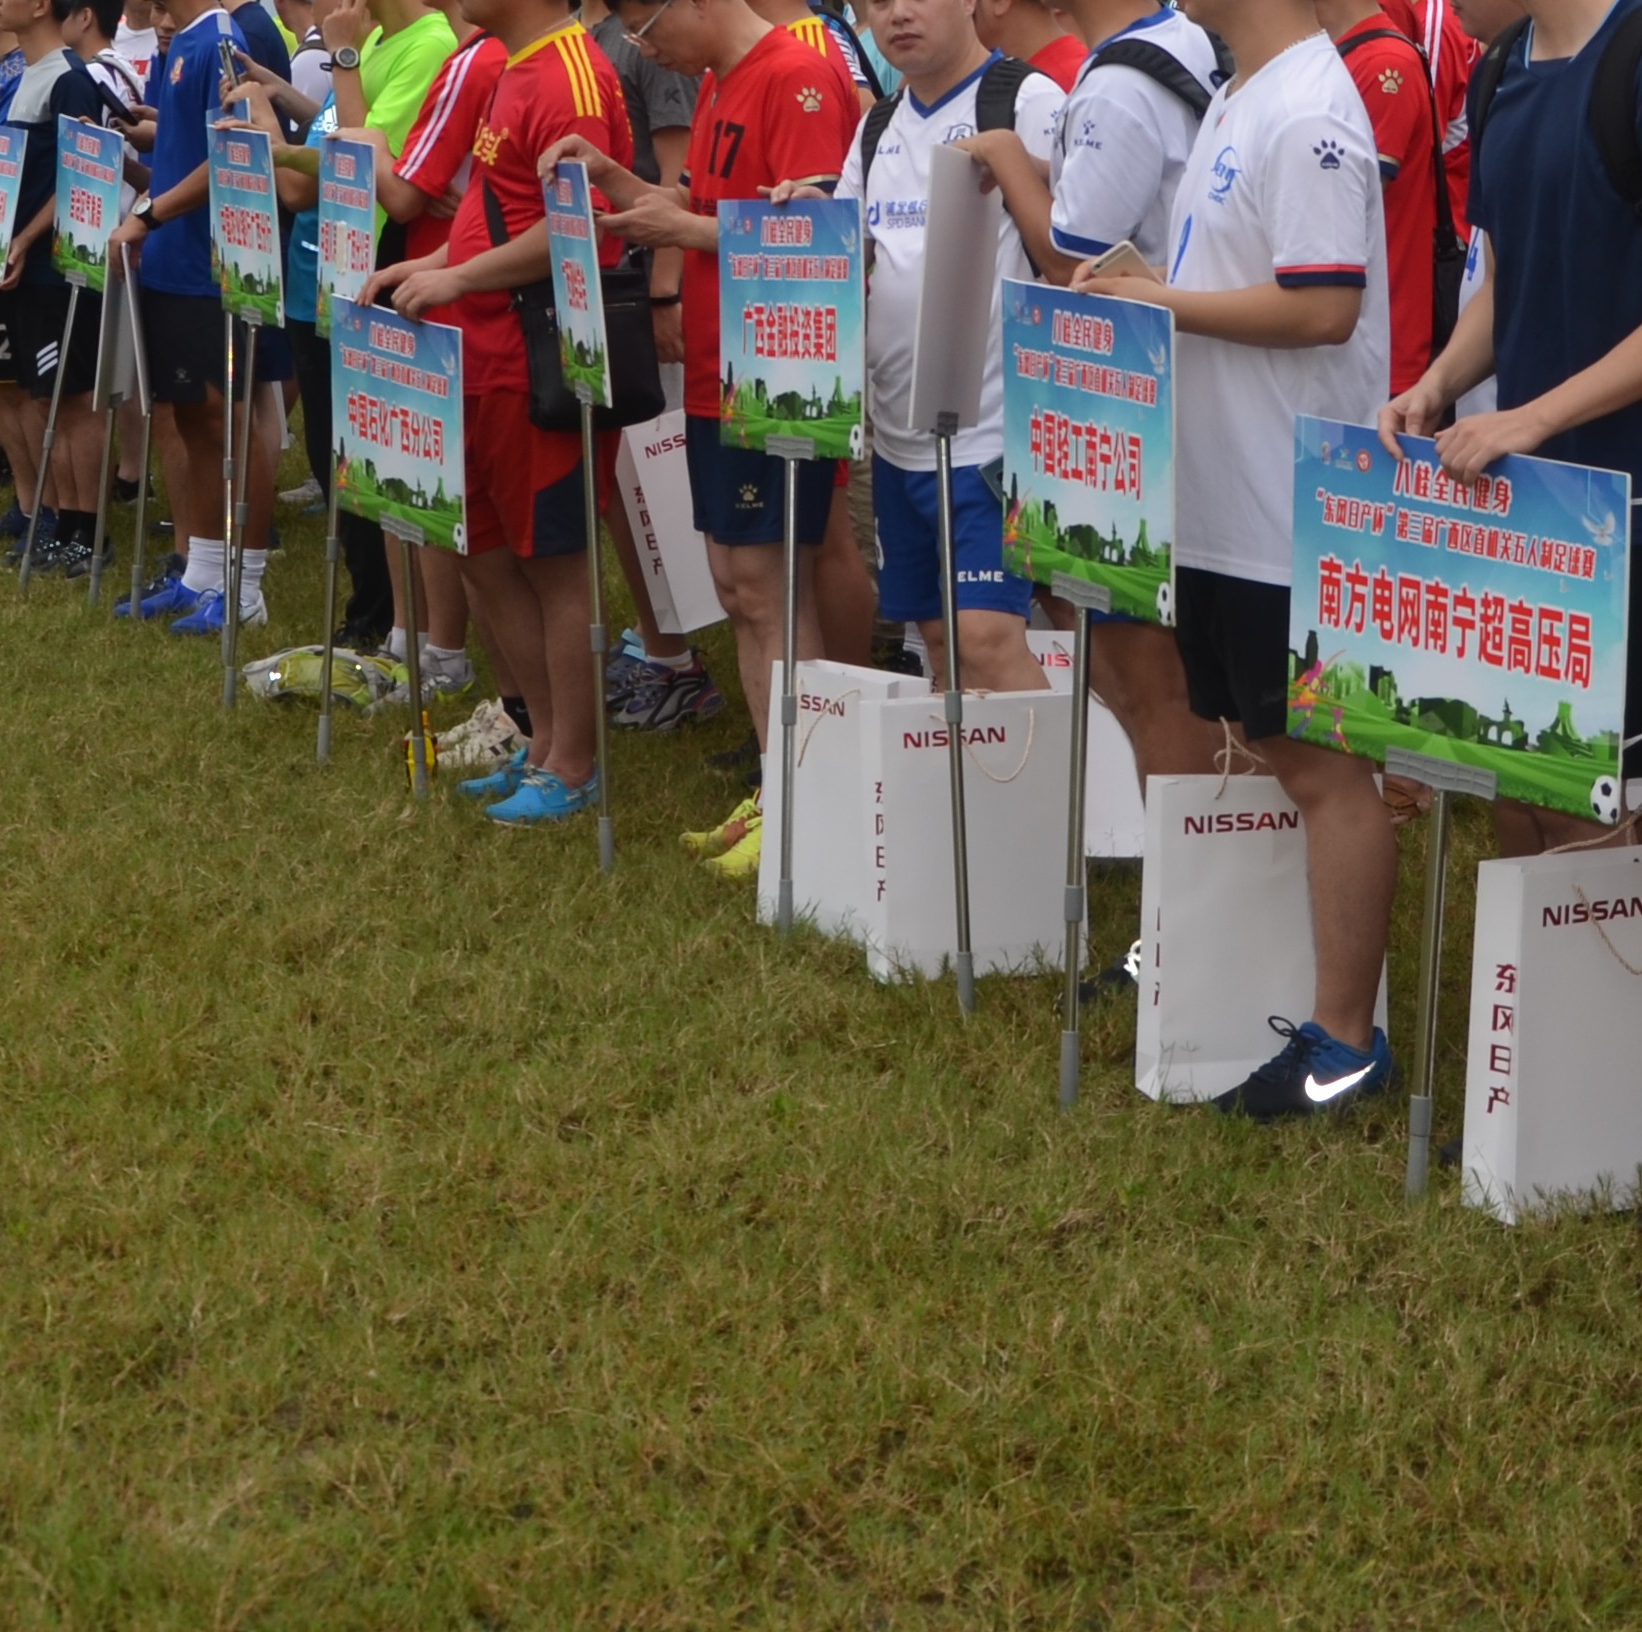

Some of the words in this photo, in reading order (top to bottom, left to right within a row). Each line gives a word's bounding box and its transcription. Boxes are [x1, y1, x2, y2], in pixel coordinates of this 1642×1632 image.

[708, 119, 746, 180] 17
[742, 302, 837, 363] 广西金融投资集团
[347, 386, 444, 466] 中国石化广西分公司
[644, 433, 689, 459] NISS
[1029, 404, 1143, 502] 中国轻工南宁公司
[1392, 457, 1514, 517] 八桂全民健身
[957, 569, 1005, 583] ELME
[1317, 554, 1594, 690] 南方电网南宁超高压局
[800, 692, 846, 718] SSAN
[1183, 809, 1300, 837] NISSAN
[1486, 962, 1517, 1116] 东风日产
